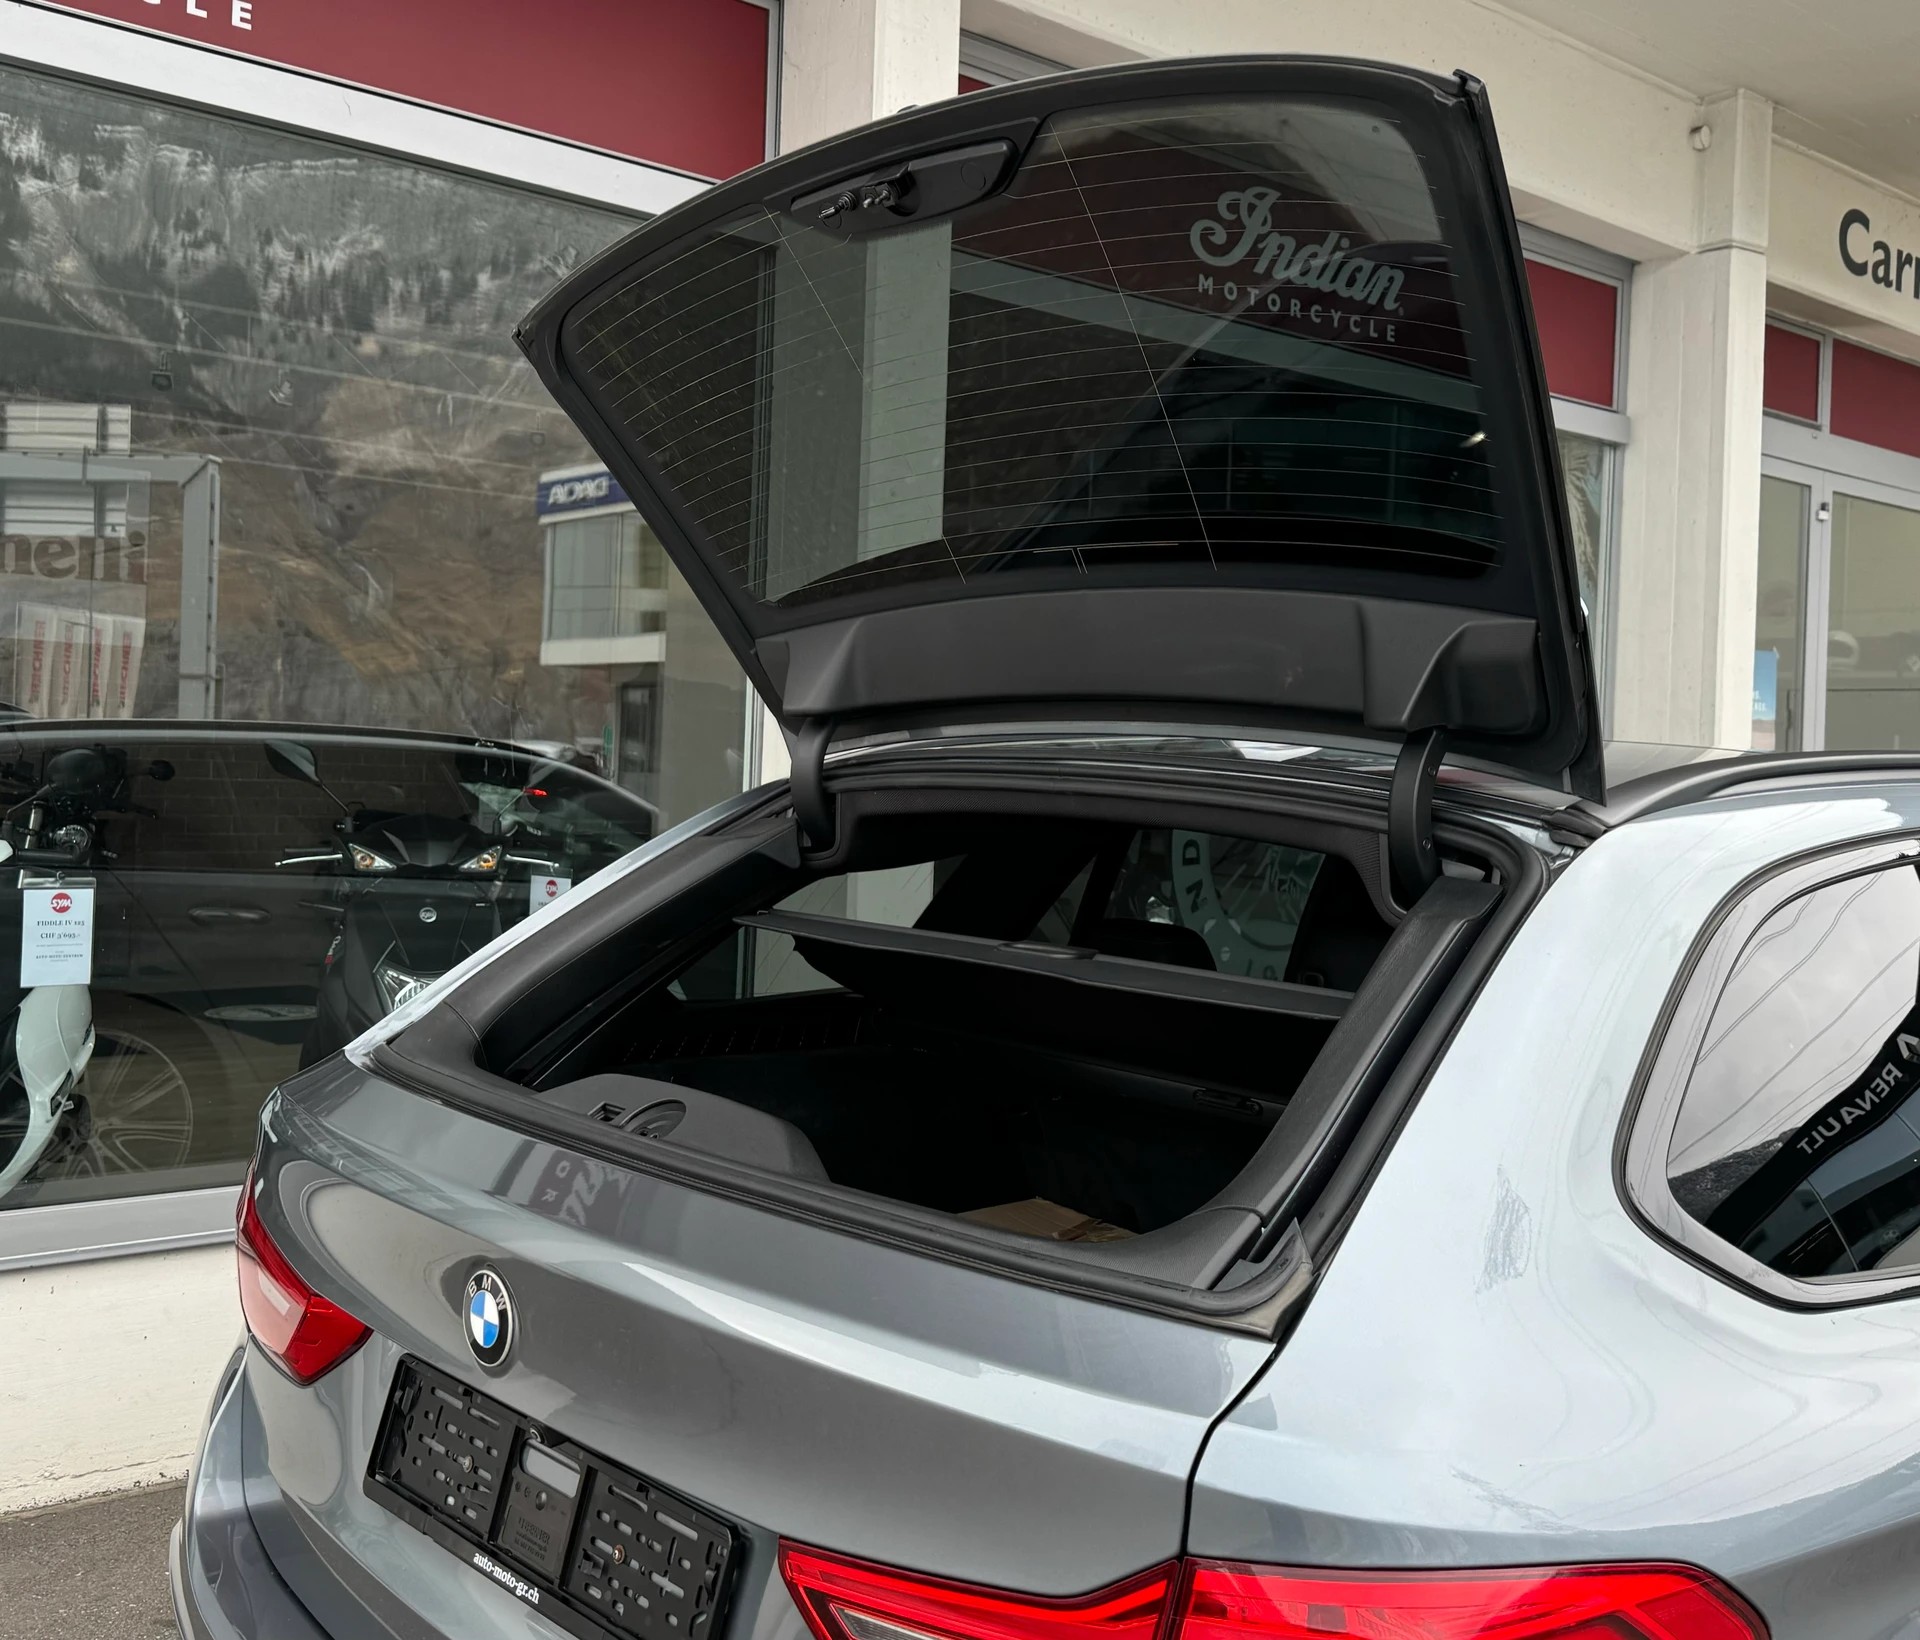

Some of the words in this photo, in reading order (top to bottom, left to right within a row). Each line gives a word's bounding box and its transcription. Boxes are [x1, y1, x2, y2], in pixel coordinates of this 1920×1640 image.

[1190, 186, 1405, 312] Indian
[1838, 208, 1920, 300] Car
[1198, 273, 1396, 342] MOTORCYCLE
[50, 898, 73, 910] SYM
[469, 1275, 507, 1311] BMW
[473, 1553, 540, 1605] auto-moto-gr.ch
